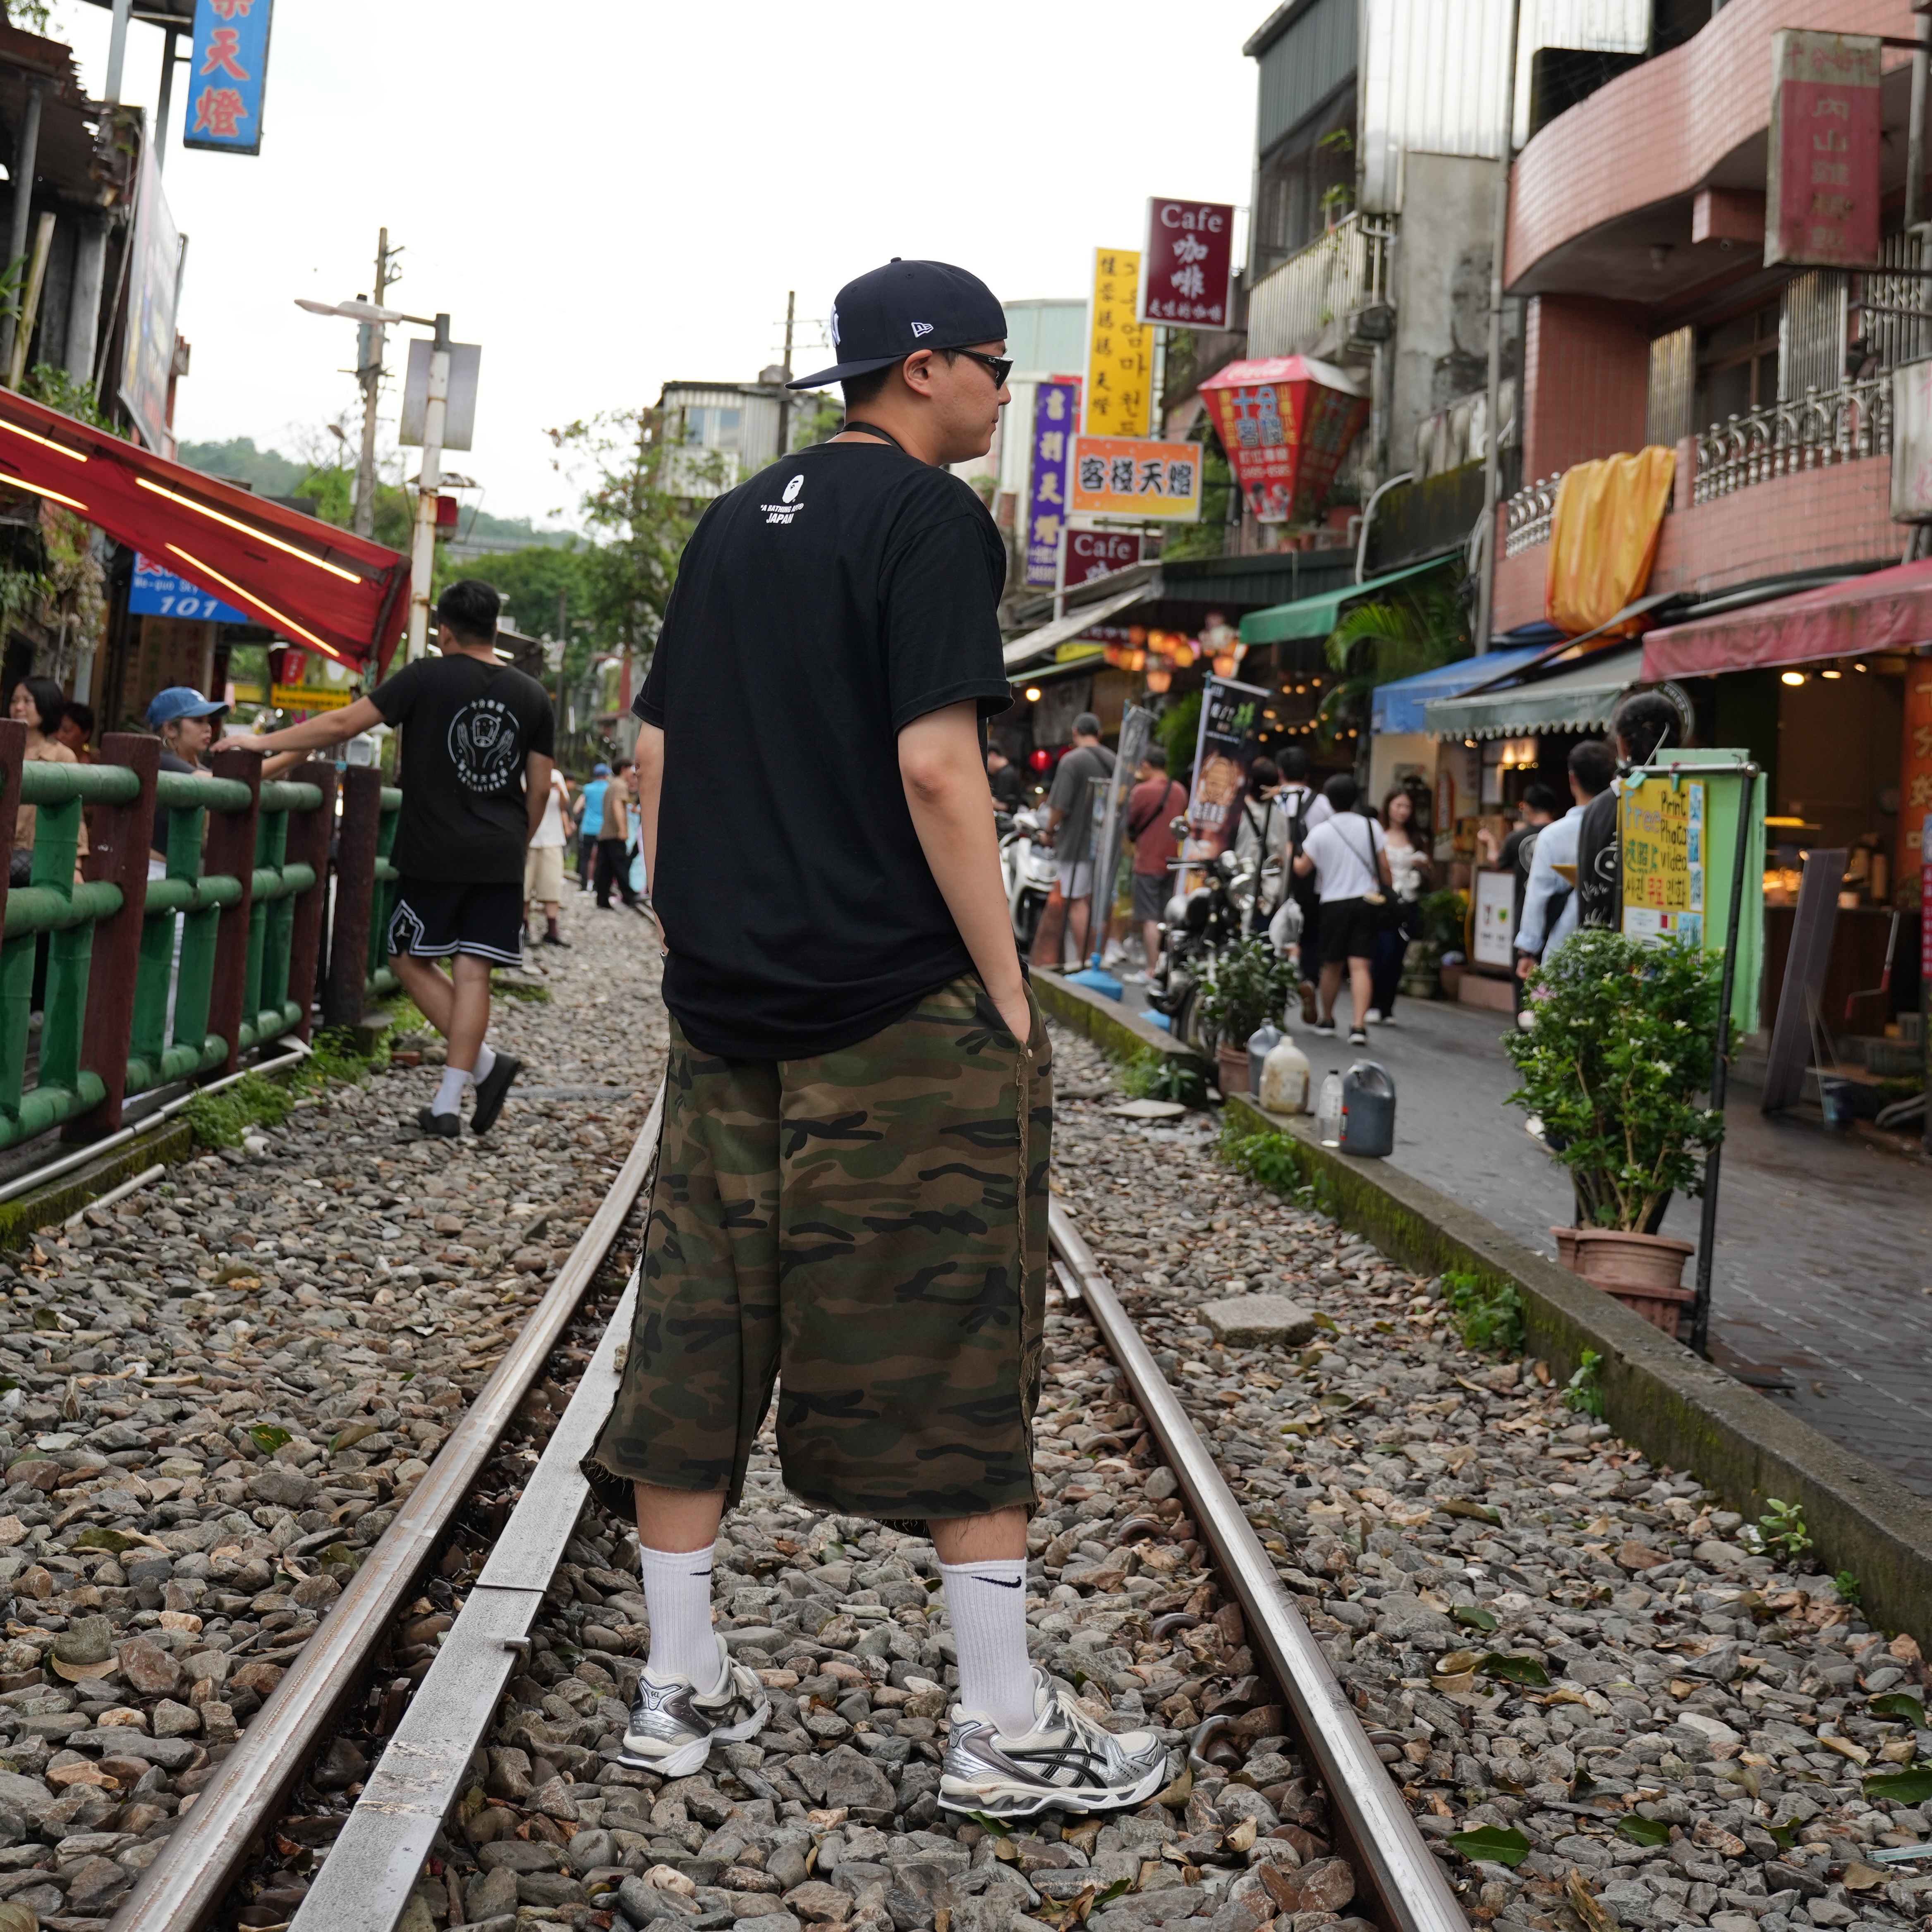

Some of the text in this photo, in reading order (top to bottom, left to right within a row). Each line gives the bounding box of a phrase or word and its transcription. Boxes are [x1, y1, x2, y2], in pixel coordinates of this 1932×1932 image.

[1161, 203, 1224, 233] Cafe
[1170, 232, 1209, 301] 咖啡
[1232, 385, 1278, 419] 十分
[1080, 455, 1192, 497] 客棧天燈
[766, 513, 794, 524] JAPAN
[1074, 534, 1131, 560] Cafe
[160, 595, 218, 618] 101
[1624, 789, 1661, 834] Free
[1660, 819, 1687, 845] Photo
[1625, 875, 1644, 901] 사진
[1648, 878, 1664, 905] 무료
[1666, 877, 1686, 909] 인화
